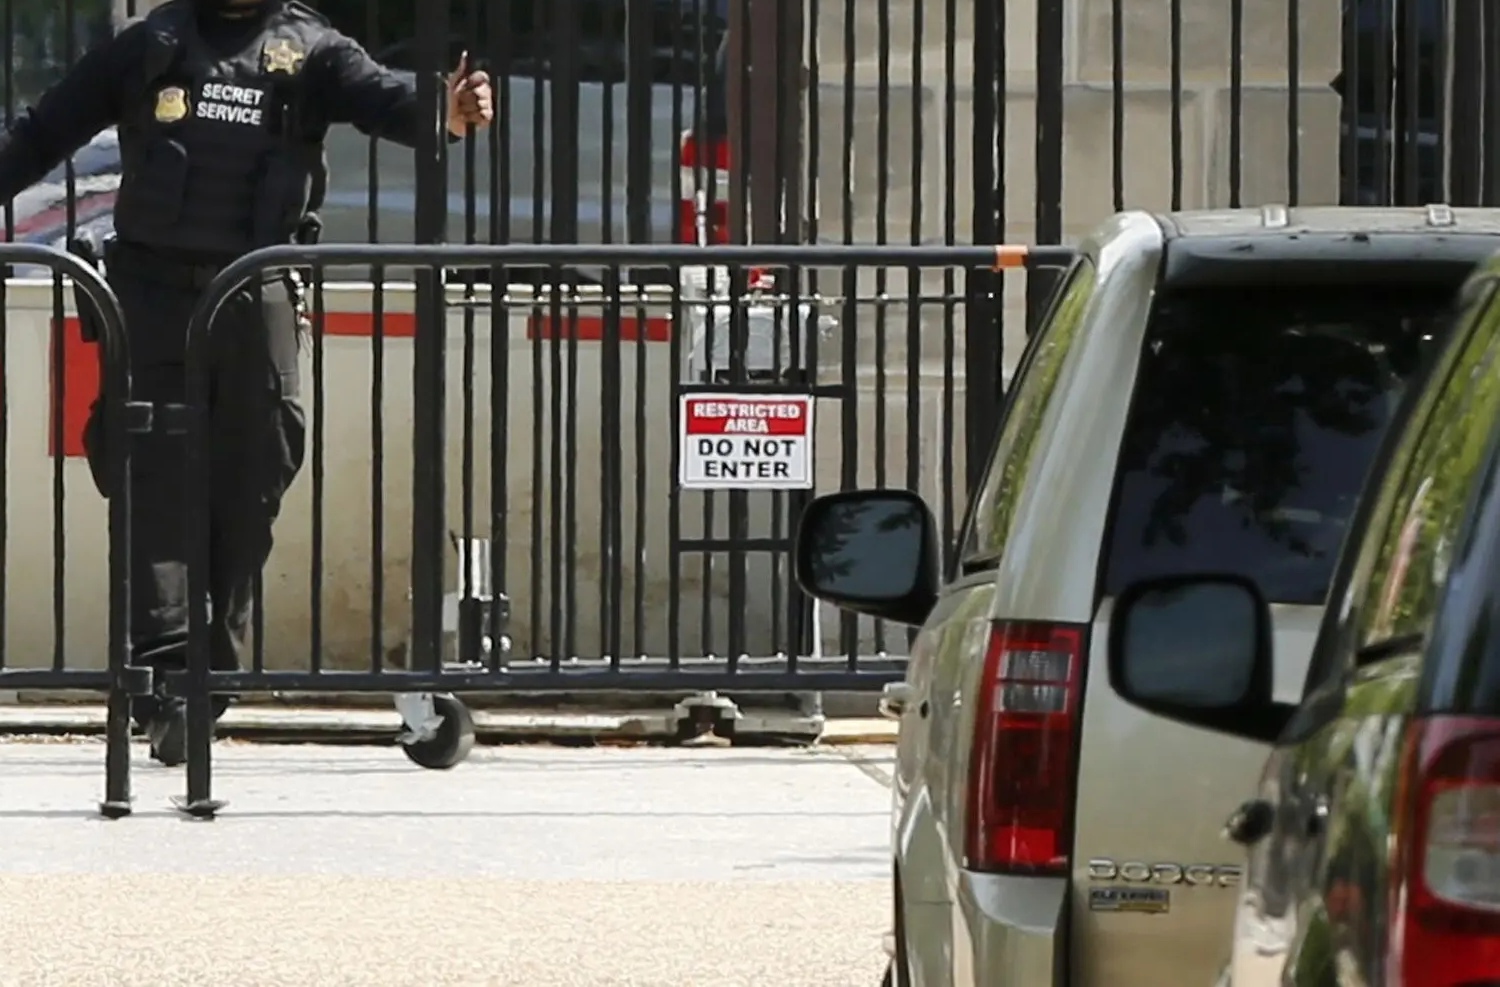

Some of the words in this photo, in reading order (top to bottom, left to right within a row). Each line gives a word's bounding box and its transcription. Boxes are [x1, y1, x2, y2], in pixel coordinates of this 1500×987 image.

[203, 83, 264, 105] SECRET
[197, 102, 263, 125] SERVICE
[694, 403, 801, 418] RESTRICTED
[724, 418, 769, 433] AREA
[699, 439, 733, 457] DO
[744, 440, 796, 457] NOT
[705, 461, 789, 478] ENTER
[1089, 857, 1242, 887] DODGE
